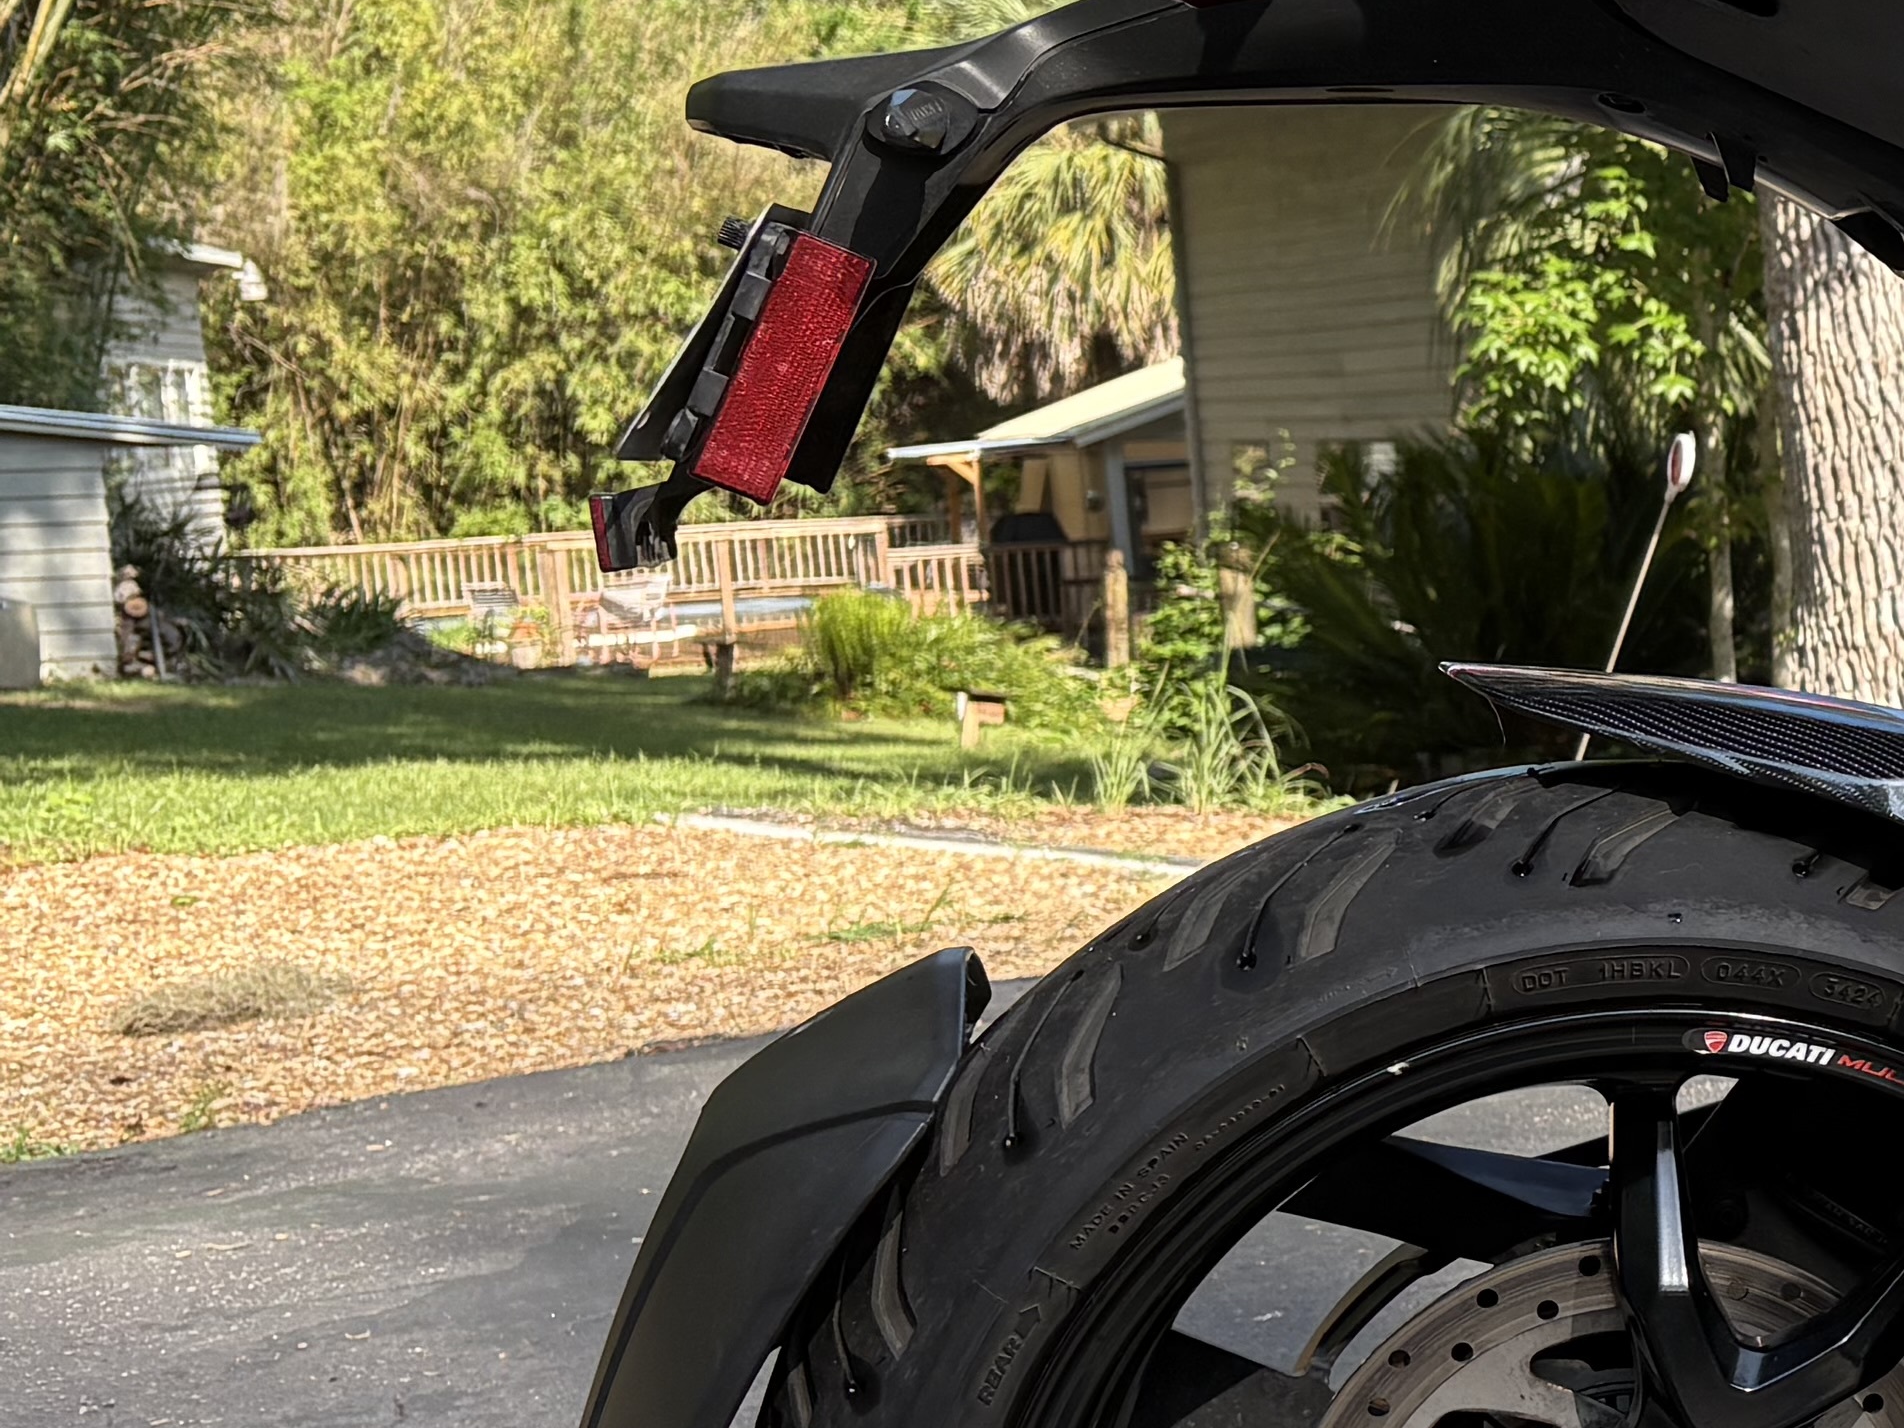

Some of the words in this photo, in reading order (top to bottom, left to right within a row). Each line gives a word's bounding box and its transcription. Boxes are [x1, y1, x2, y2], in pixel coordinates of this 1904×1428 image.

[1521, 968, 1569, 992] DOT
[1727, 1033, 1836, 1067] DUCATI
[1068, 1200, 1114, 1253] MADE
[1111, 1177, 1135, 1204] IN
[1135, 1128, 1190, 1185] SPAIN
